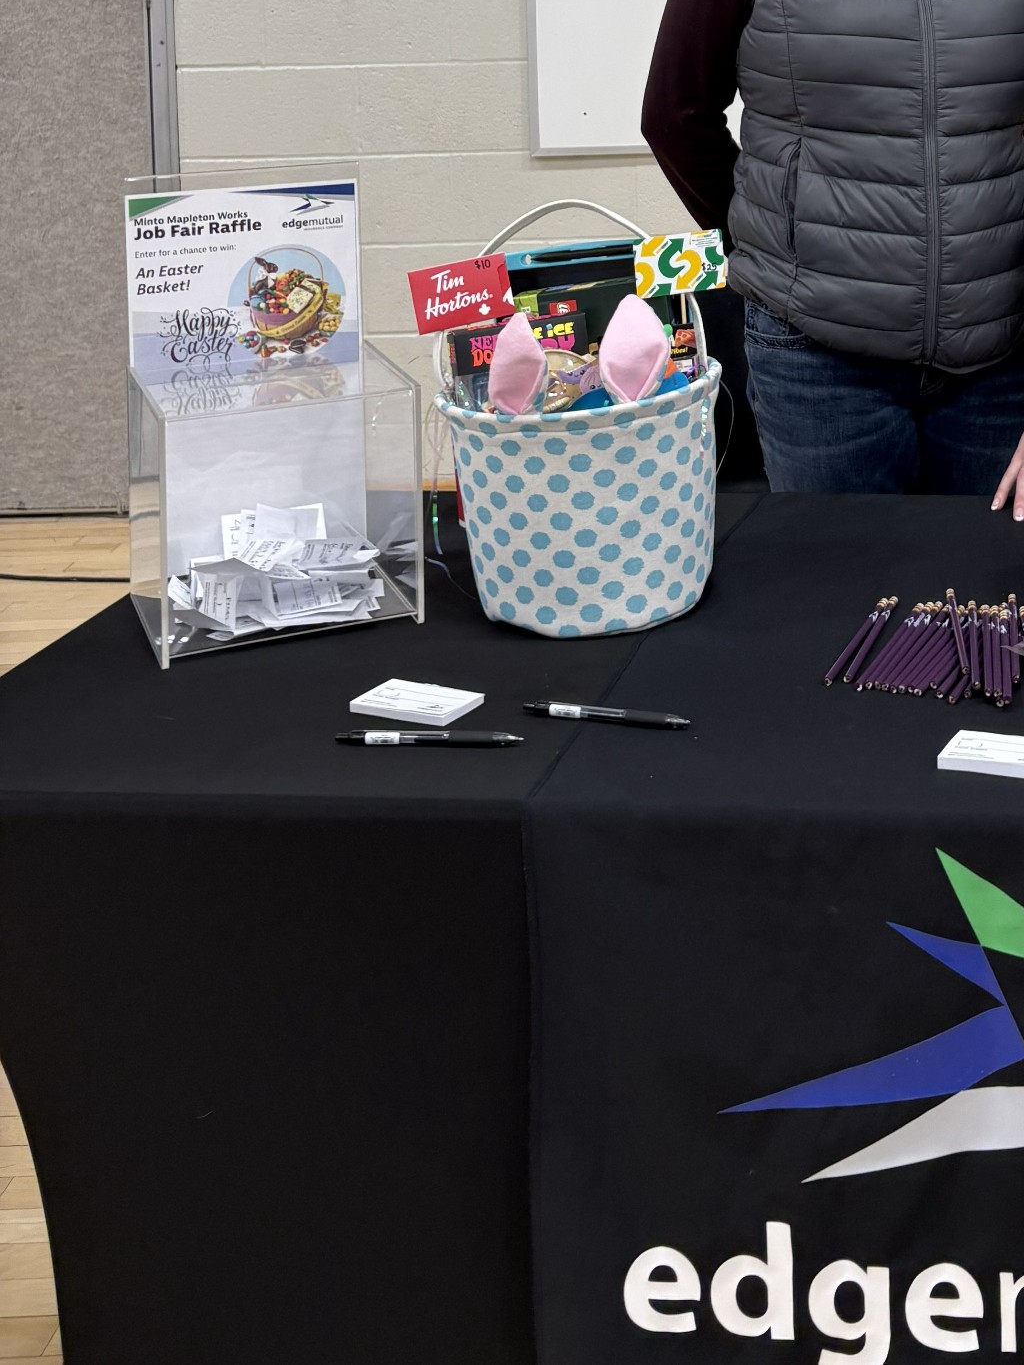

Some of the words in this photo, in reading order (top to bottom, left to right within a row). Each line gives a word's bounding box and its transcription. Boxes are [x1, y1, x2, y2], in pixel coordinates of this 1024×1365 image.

[133, 217, 165, 227] Minto
[167, 213, 216, 225] Mapleton
[217, 210, 249, 220] Works
[282, 215, 344, 229] edgemutual
[134, 226, 166, 241] Job
[171, 223, 205, 237] Fair
[209, 218, 263, 235] Raffle
[135, 250, 156, 259] Enter
[158, 249, 171, 257] for
[179, 245, 208, 255] chance
[209, 245, 219, 254] to
[220, 243, 237, 252] win:
[135, 267, 155, 280] An
[158, 263, 204, 277] Easter
[430, 269, 465, 294] Tim
[136, 279, 191, 296] Basket!
[424, 288, 490, 320] Hortons
[165, 307, 240, 341] Happy
[163, 333, 233, 363] Easter
